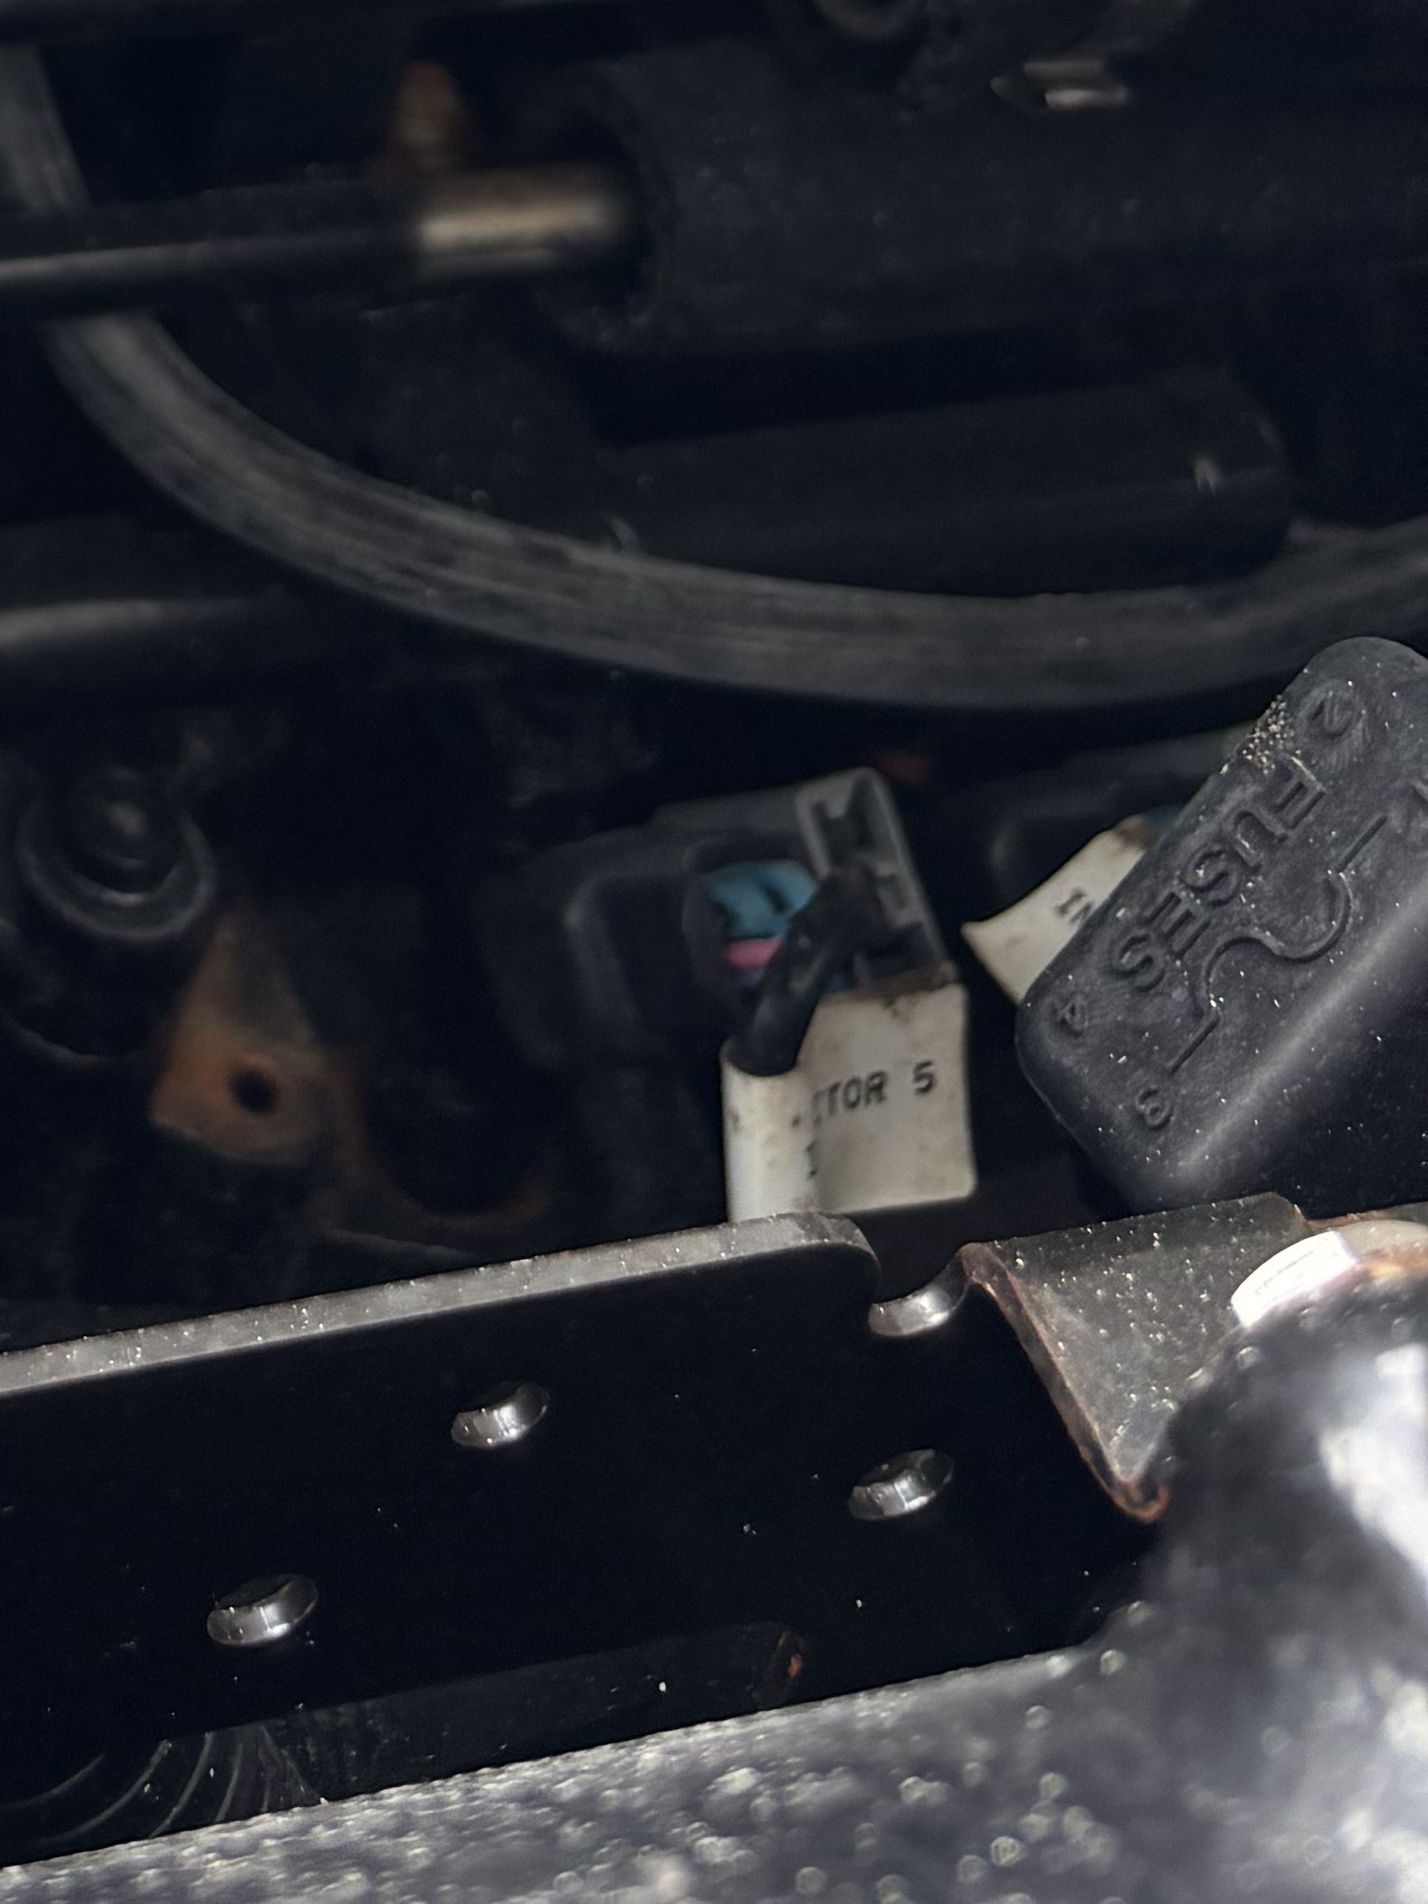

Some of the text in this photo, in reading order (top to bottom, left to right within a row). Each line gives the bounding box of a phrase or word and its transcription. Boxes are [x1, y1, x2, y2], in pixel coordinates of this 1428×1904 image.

[1110, 754, 1328, 995] FUSES
[913, 1058, 938, 1094] 5
[1137, 1084, 1177, 1131] 3
